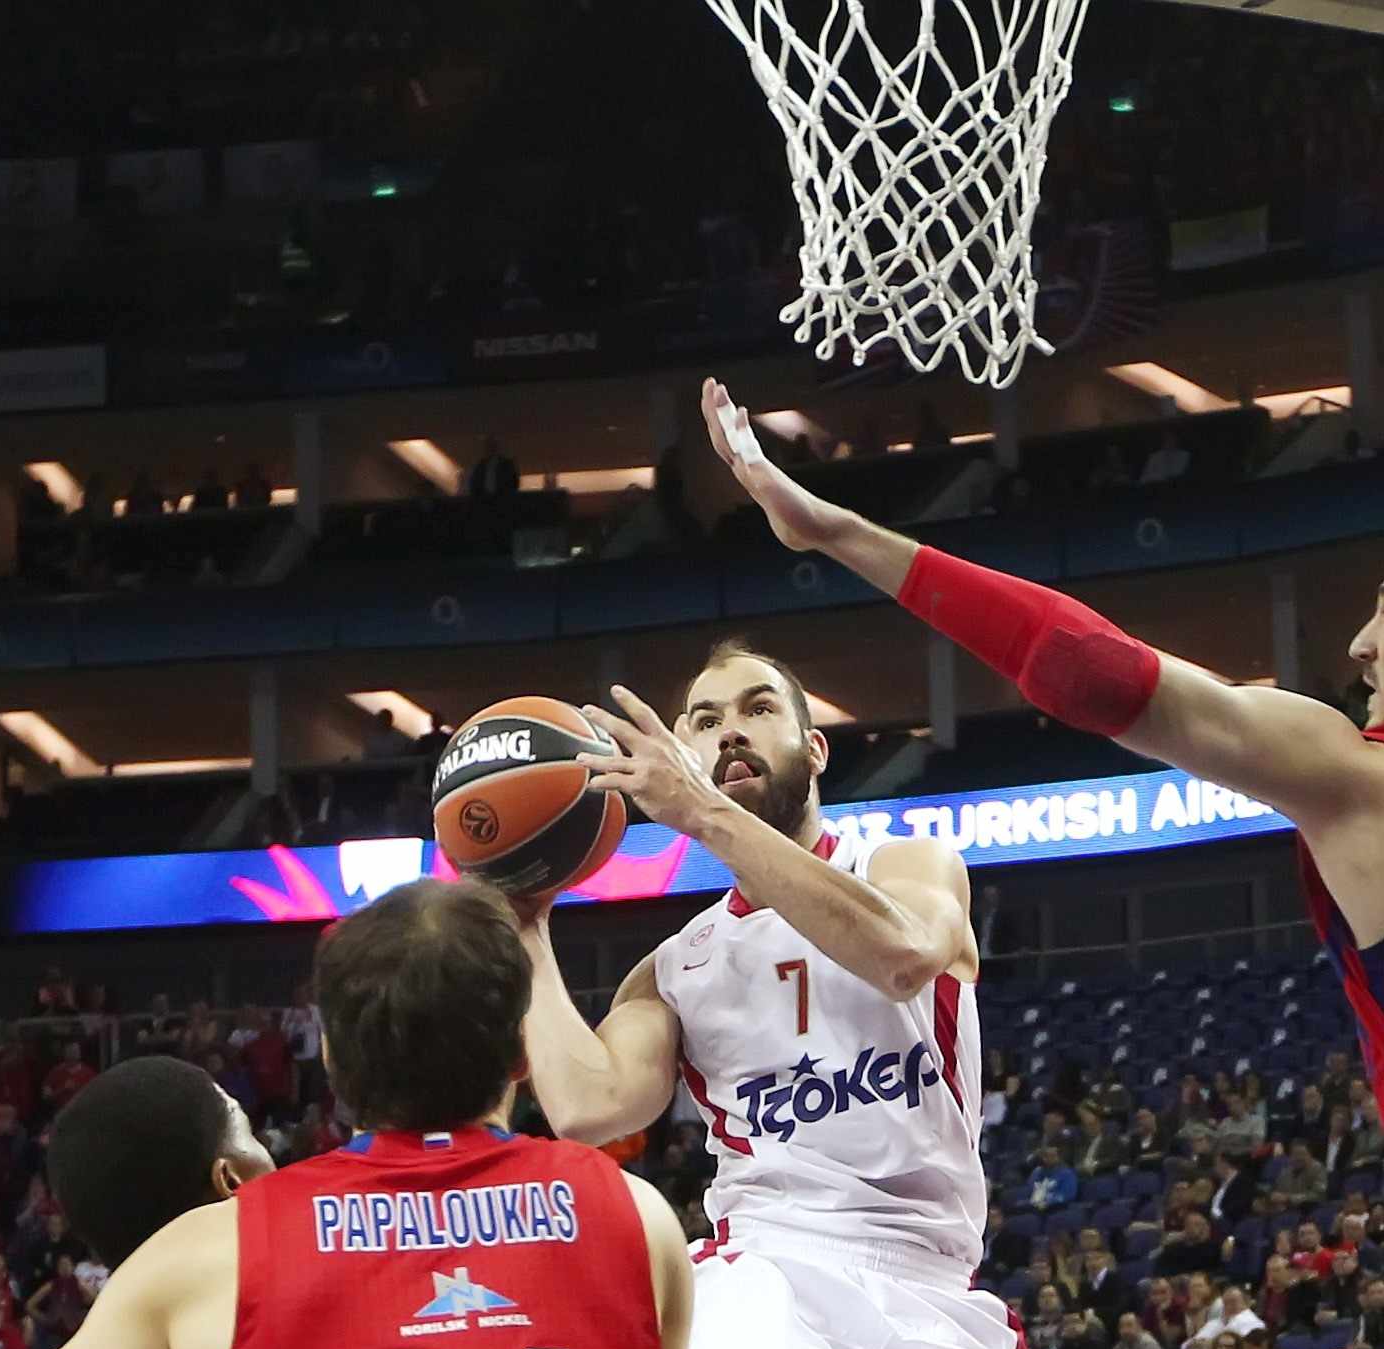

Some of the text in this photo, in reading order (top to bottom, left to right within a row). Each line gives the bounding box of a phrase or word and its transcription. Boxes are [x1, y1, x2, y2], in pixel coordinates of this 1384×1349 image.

[903, 788, 1138, 850] TURKISH
[775, 959, 808, 1036] 7
[313, 1180, 578, 1251] PAPALOUKAS
